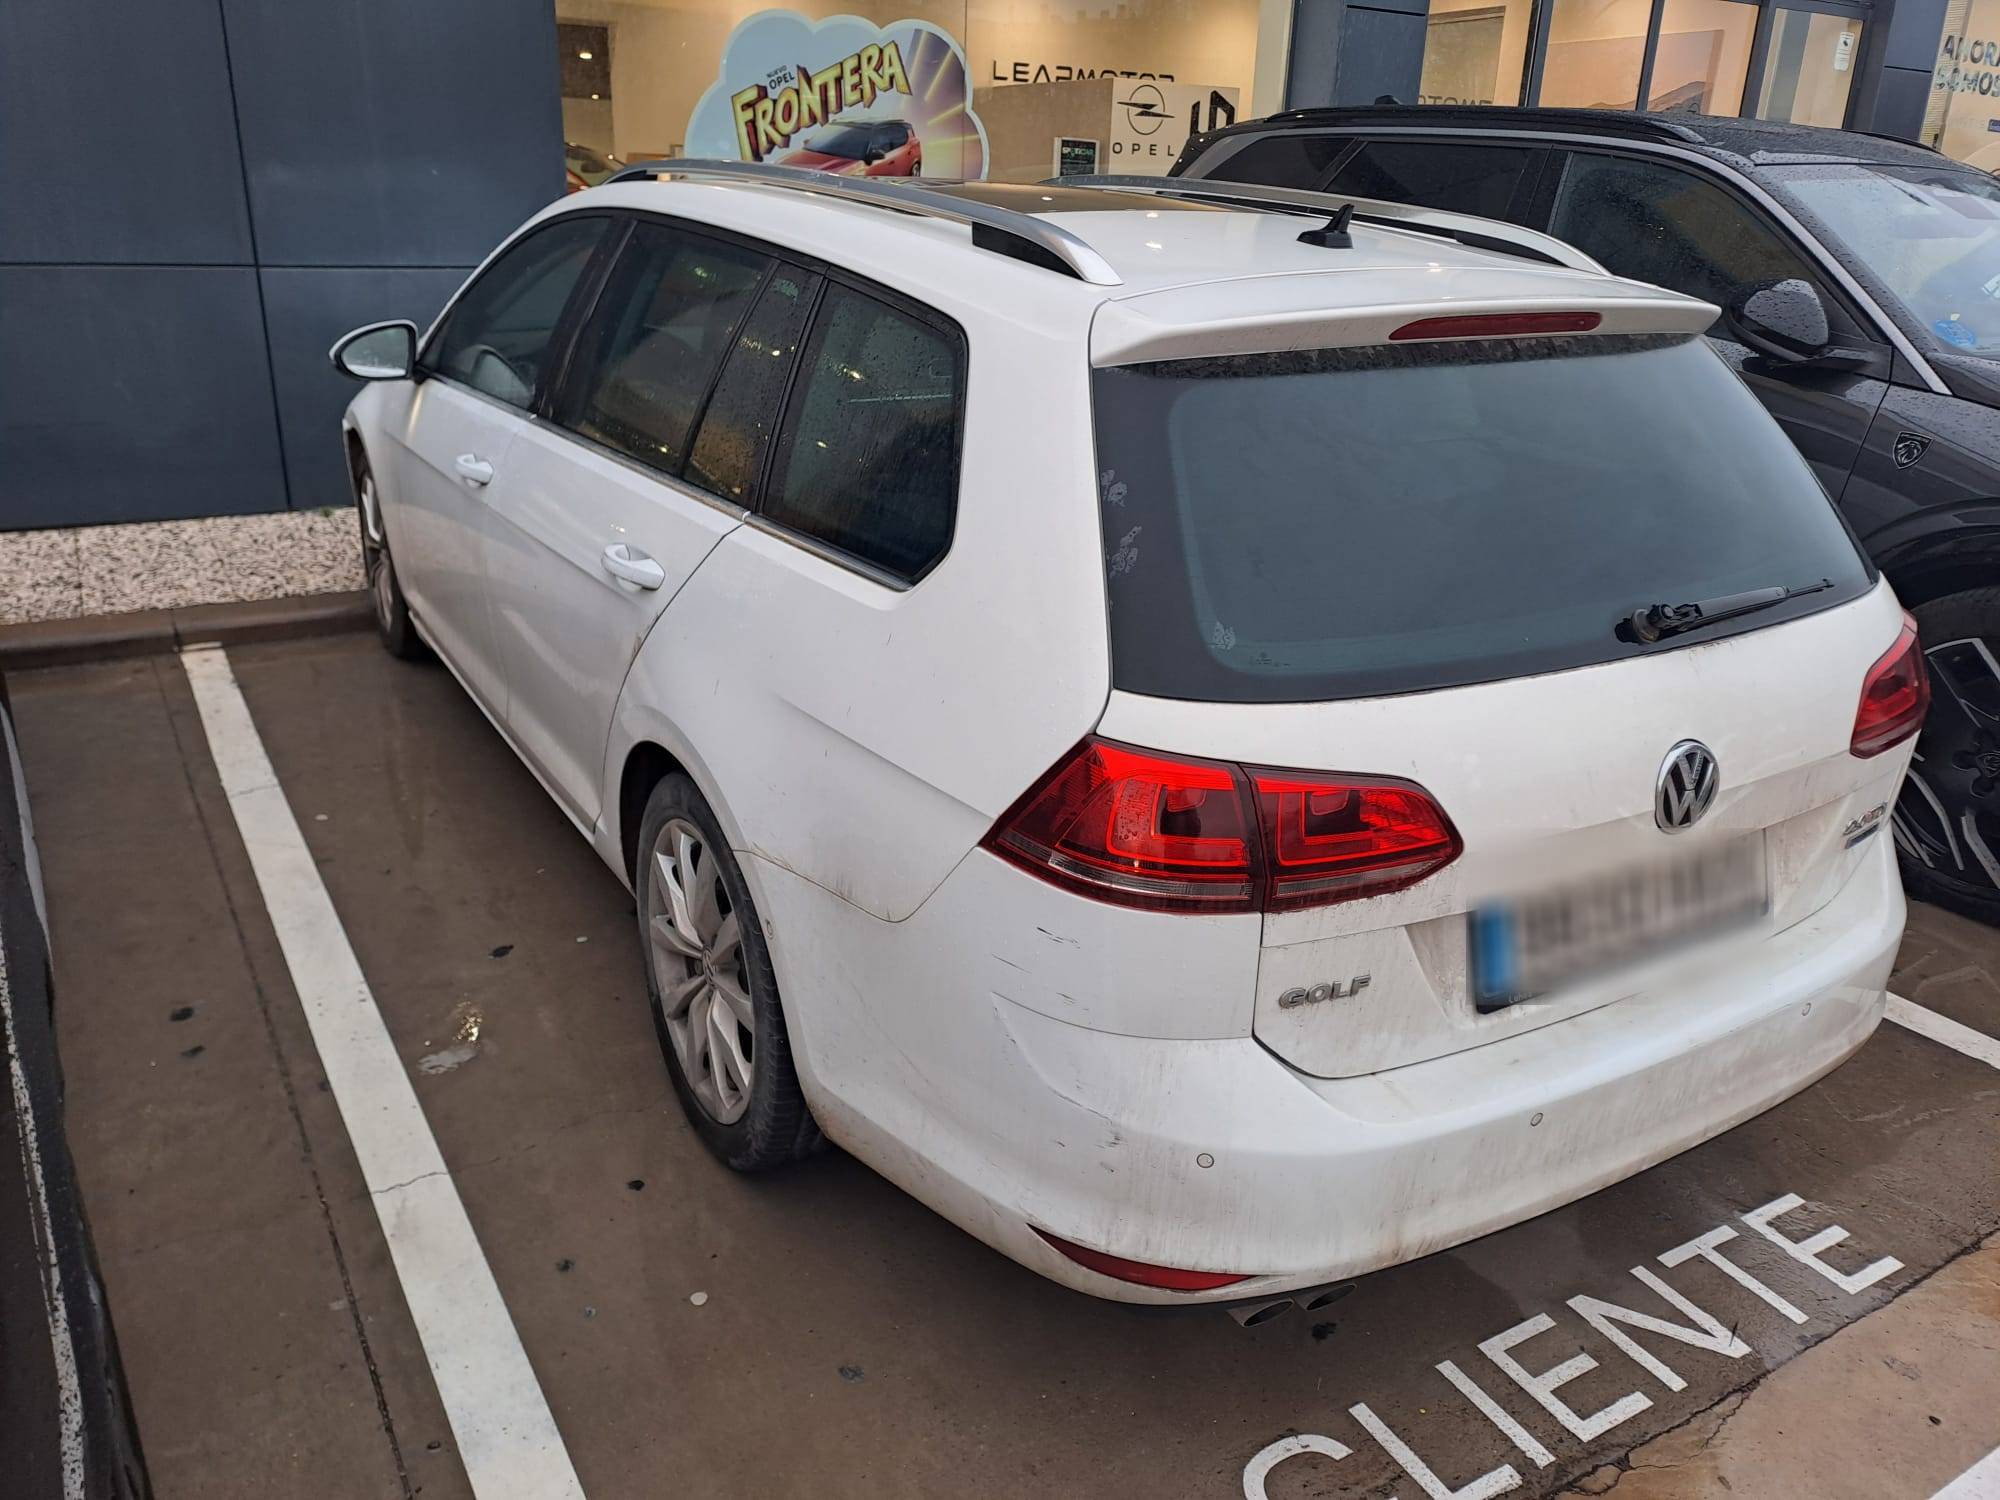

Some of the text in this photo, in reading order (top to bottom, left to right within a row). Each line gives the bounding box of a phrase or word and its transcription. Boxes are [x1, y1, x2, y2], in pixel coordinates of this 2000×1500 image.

[1942, 35, 2000, 67] AHOR
[769, 73, 795, 90] OPEL
[731, 40, 913, 162] FRONTERA
[1112, 142, 1175, 157] OPEL
[1279, 974, 1371, 1009] GOLF
[1243, 1193, 1905, 1500] CLIENTE
